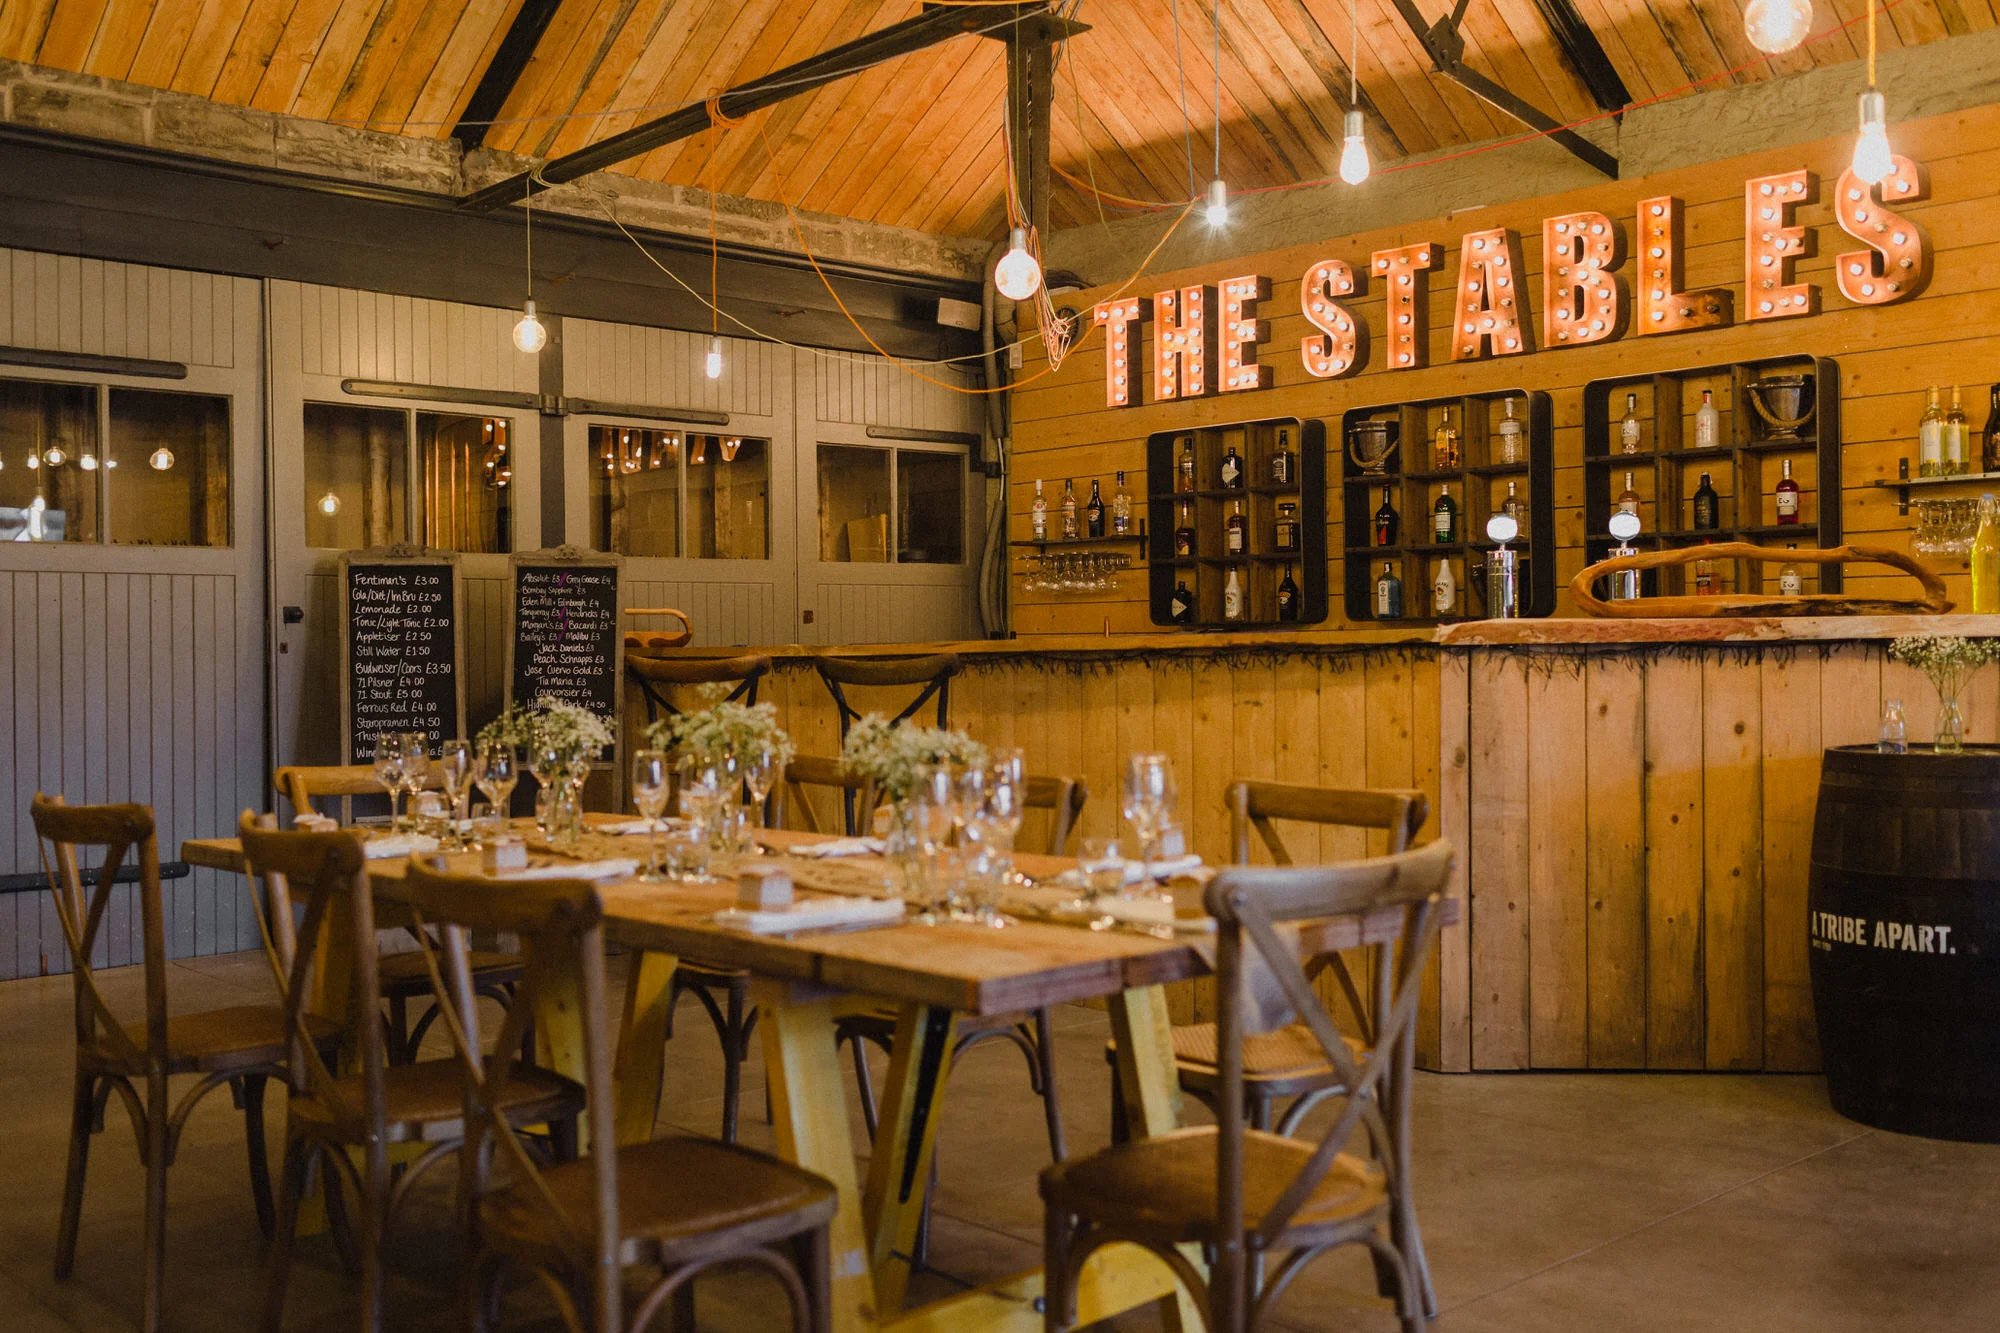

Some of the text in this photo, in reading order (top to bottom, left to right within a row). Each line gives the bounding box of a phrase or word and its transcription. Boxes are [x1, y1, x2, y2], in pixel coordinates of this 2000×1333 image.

[1094, 154, 1934, 408] THE STABLES
[354, 573, 407, 586] Fentiman's
[522, 573, 550, 583] Absolut
[521, 597, 539, 607] Eden
[355, 603, 432, 614] Lemonade £2.00
[400, 618, 421, 628] Tonic
[424, 617, 449, 628] £2.00
[568, 620, 597, 630] Bacardi
[356, 631, 400, 644] Appletiser
[356, 645, 430, 657] Still Water £1.50
[538, 643, 558, 654] Jack
[559, 643, 585, 652] Daniels
[533, 653, 557, 664] Peach
[559, 654, 592, 665] Schnapps
[426, 662, 451, 674] £3.50
[524, 664, 543, 677] Jose
[546, 665, 571, 675] Cuervo
[572, 666, 592, 675] Gold
[356, 678, 366, 688] 71
[367, 677, 394, 687] Pilsner
[536, 675, 549, 686] Tia
[550, 677, 573, 686] Maria
[356, 690, 367, 700] 71
[370, 689, 392, 699] Stout
[357, 702, 389, 713] Ferrous
[390, 700, 407, 712] Red
[356, 717, 410, 730] Staropramen
[1819, 912, 1867, 946] TRIBE
[1873, 921, 1956, 955] APART.
